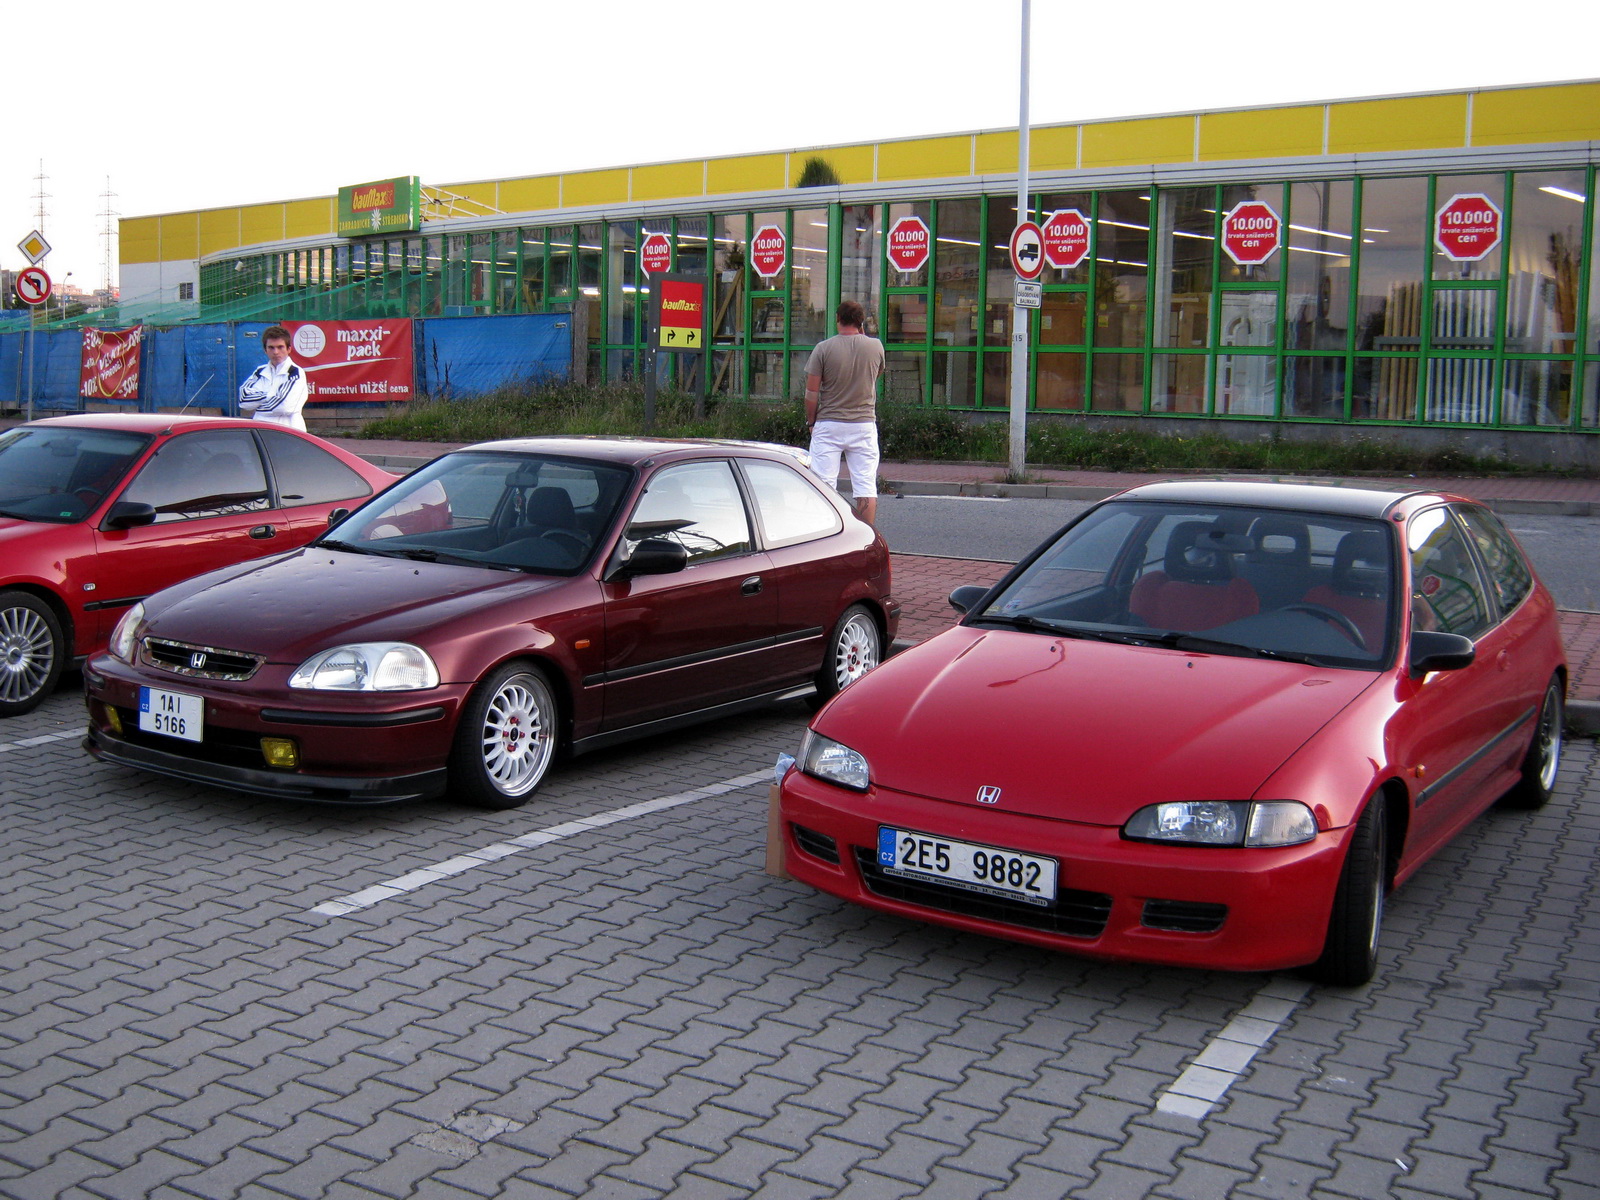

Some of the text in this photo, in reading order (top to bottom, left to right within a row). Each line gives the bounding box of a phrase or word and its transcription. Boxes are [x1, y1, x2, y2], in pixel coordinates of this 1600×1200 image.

[1231, 217, 1273, 230] 10.000
[1445, 210, 1493, 225] 10.000
[894, 230, 925, 242] 10.000
[1048, 224, 1084, 237] 10.000
[756, 238, 782, 250] 10.000
[1241, 240, 1260, 248] cen
[1457, 234, 1478, 243] cen
[645, 244, 668, 255] 10.000
[901, 250, 915, 258] cen
[1057, 245, 1073, 253] cen
[337, 325, 391, 342] maxxi-
[346, 340, 381, 361] pack
[318, 385, 358, 395] množství
[359, 380, 388, 394] nižší
[389, 385, 409, 394] cena
[160, 694, 181, 714] 1AI
[155, 713, 186, 735] 5166
[881, 837, 1042, 892] CZ 2E5 9882
